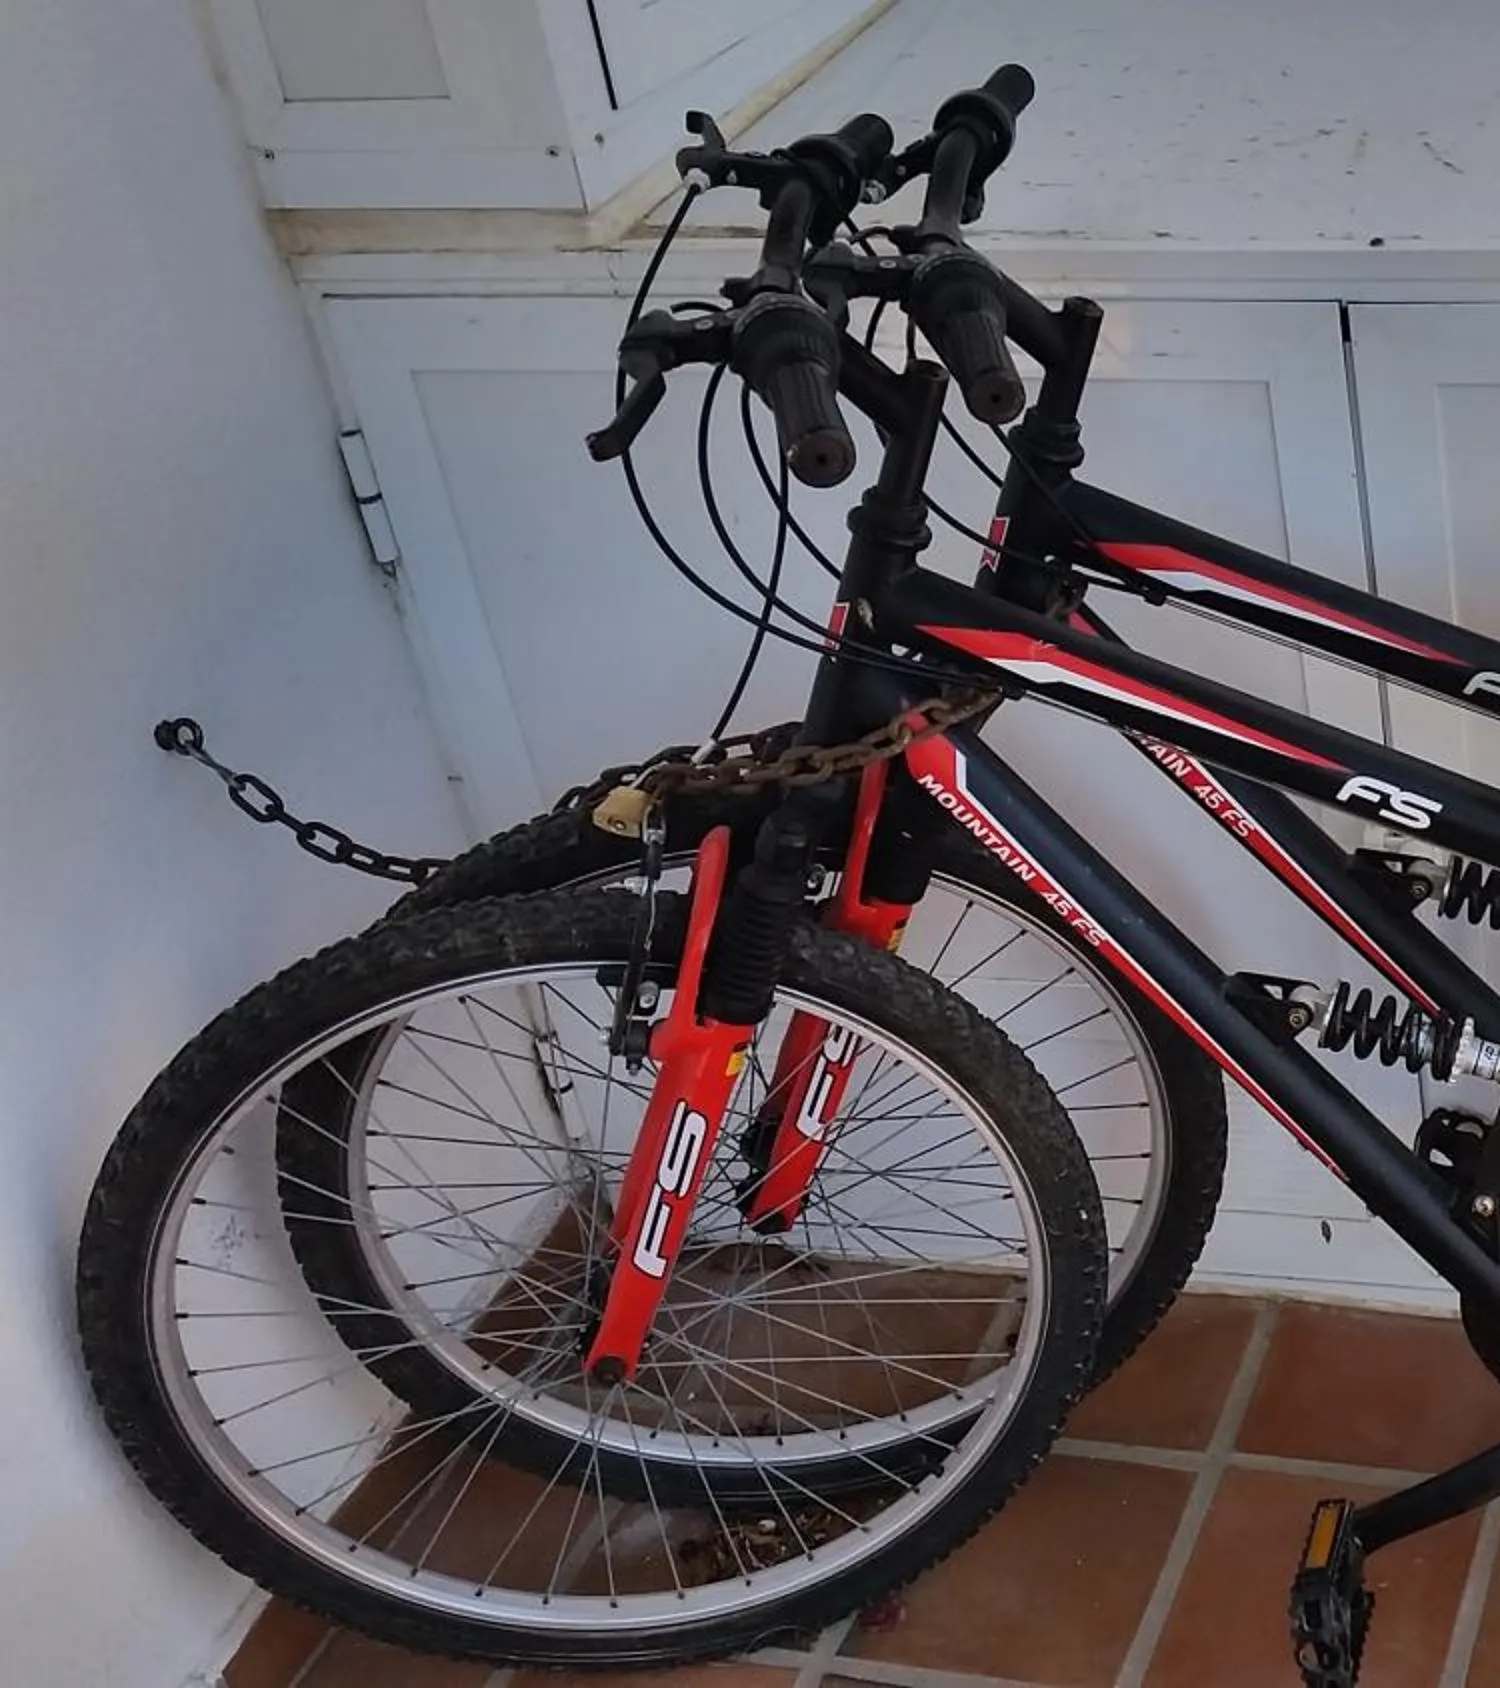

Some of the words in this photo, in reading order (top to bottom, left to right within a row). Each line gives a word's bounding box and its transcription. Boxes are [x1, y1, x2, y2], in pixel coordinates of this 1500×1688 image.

[1193, 785, 1225, 809] 45
[1220, 809, 1255, 838] FS
[1335, 775, 1443, 830] FS
[917, 773, 1037, 882] MOUNTAIN
[1040, 890, 1074, 917] 45
[1070, 918, 1107, 947] FS
[633, 1099, 707, 1279] FS
